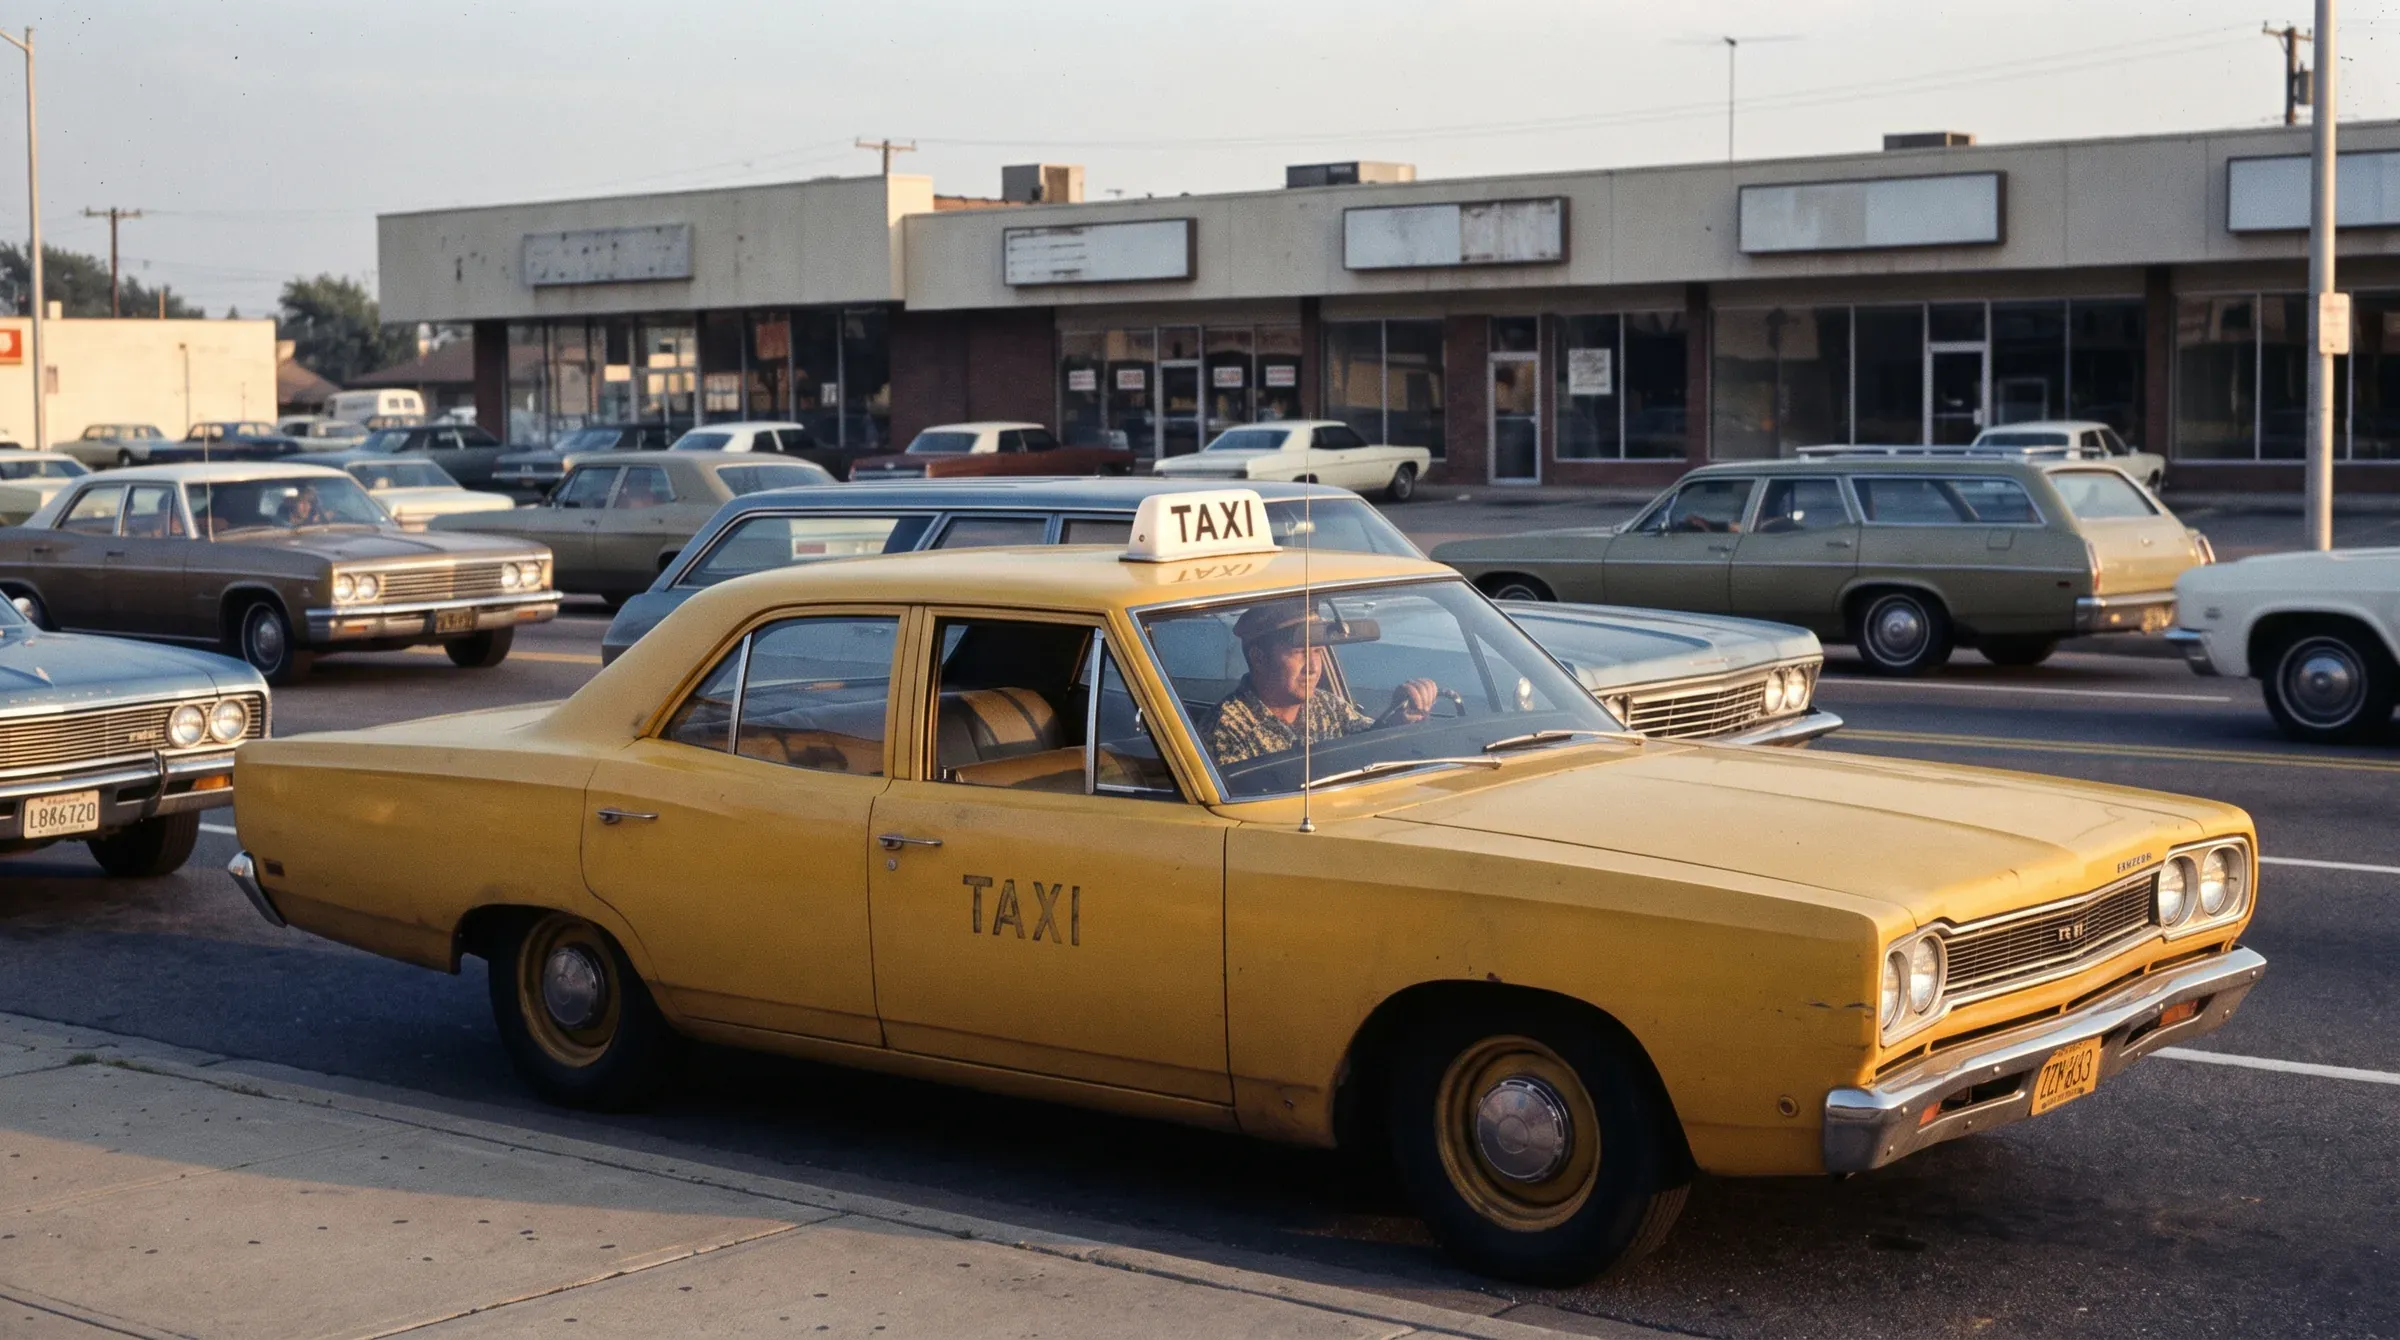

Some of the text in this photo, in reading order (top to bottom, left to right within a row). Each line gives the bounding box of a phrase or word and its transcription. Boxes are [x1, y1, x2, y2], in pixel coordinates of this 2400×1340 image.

[1170, 499, 1254, 543] TAXI
[30, 802, 96, 829] L886720
[963, 874, 1080, 946] TAXI
